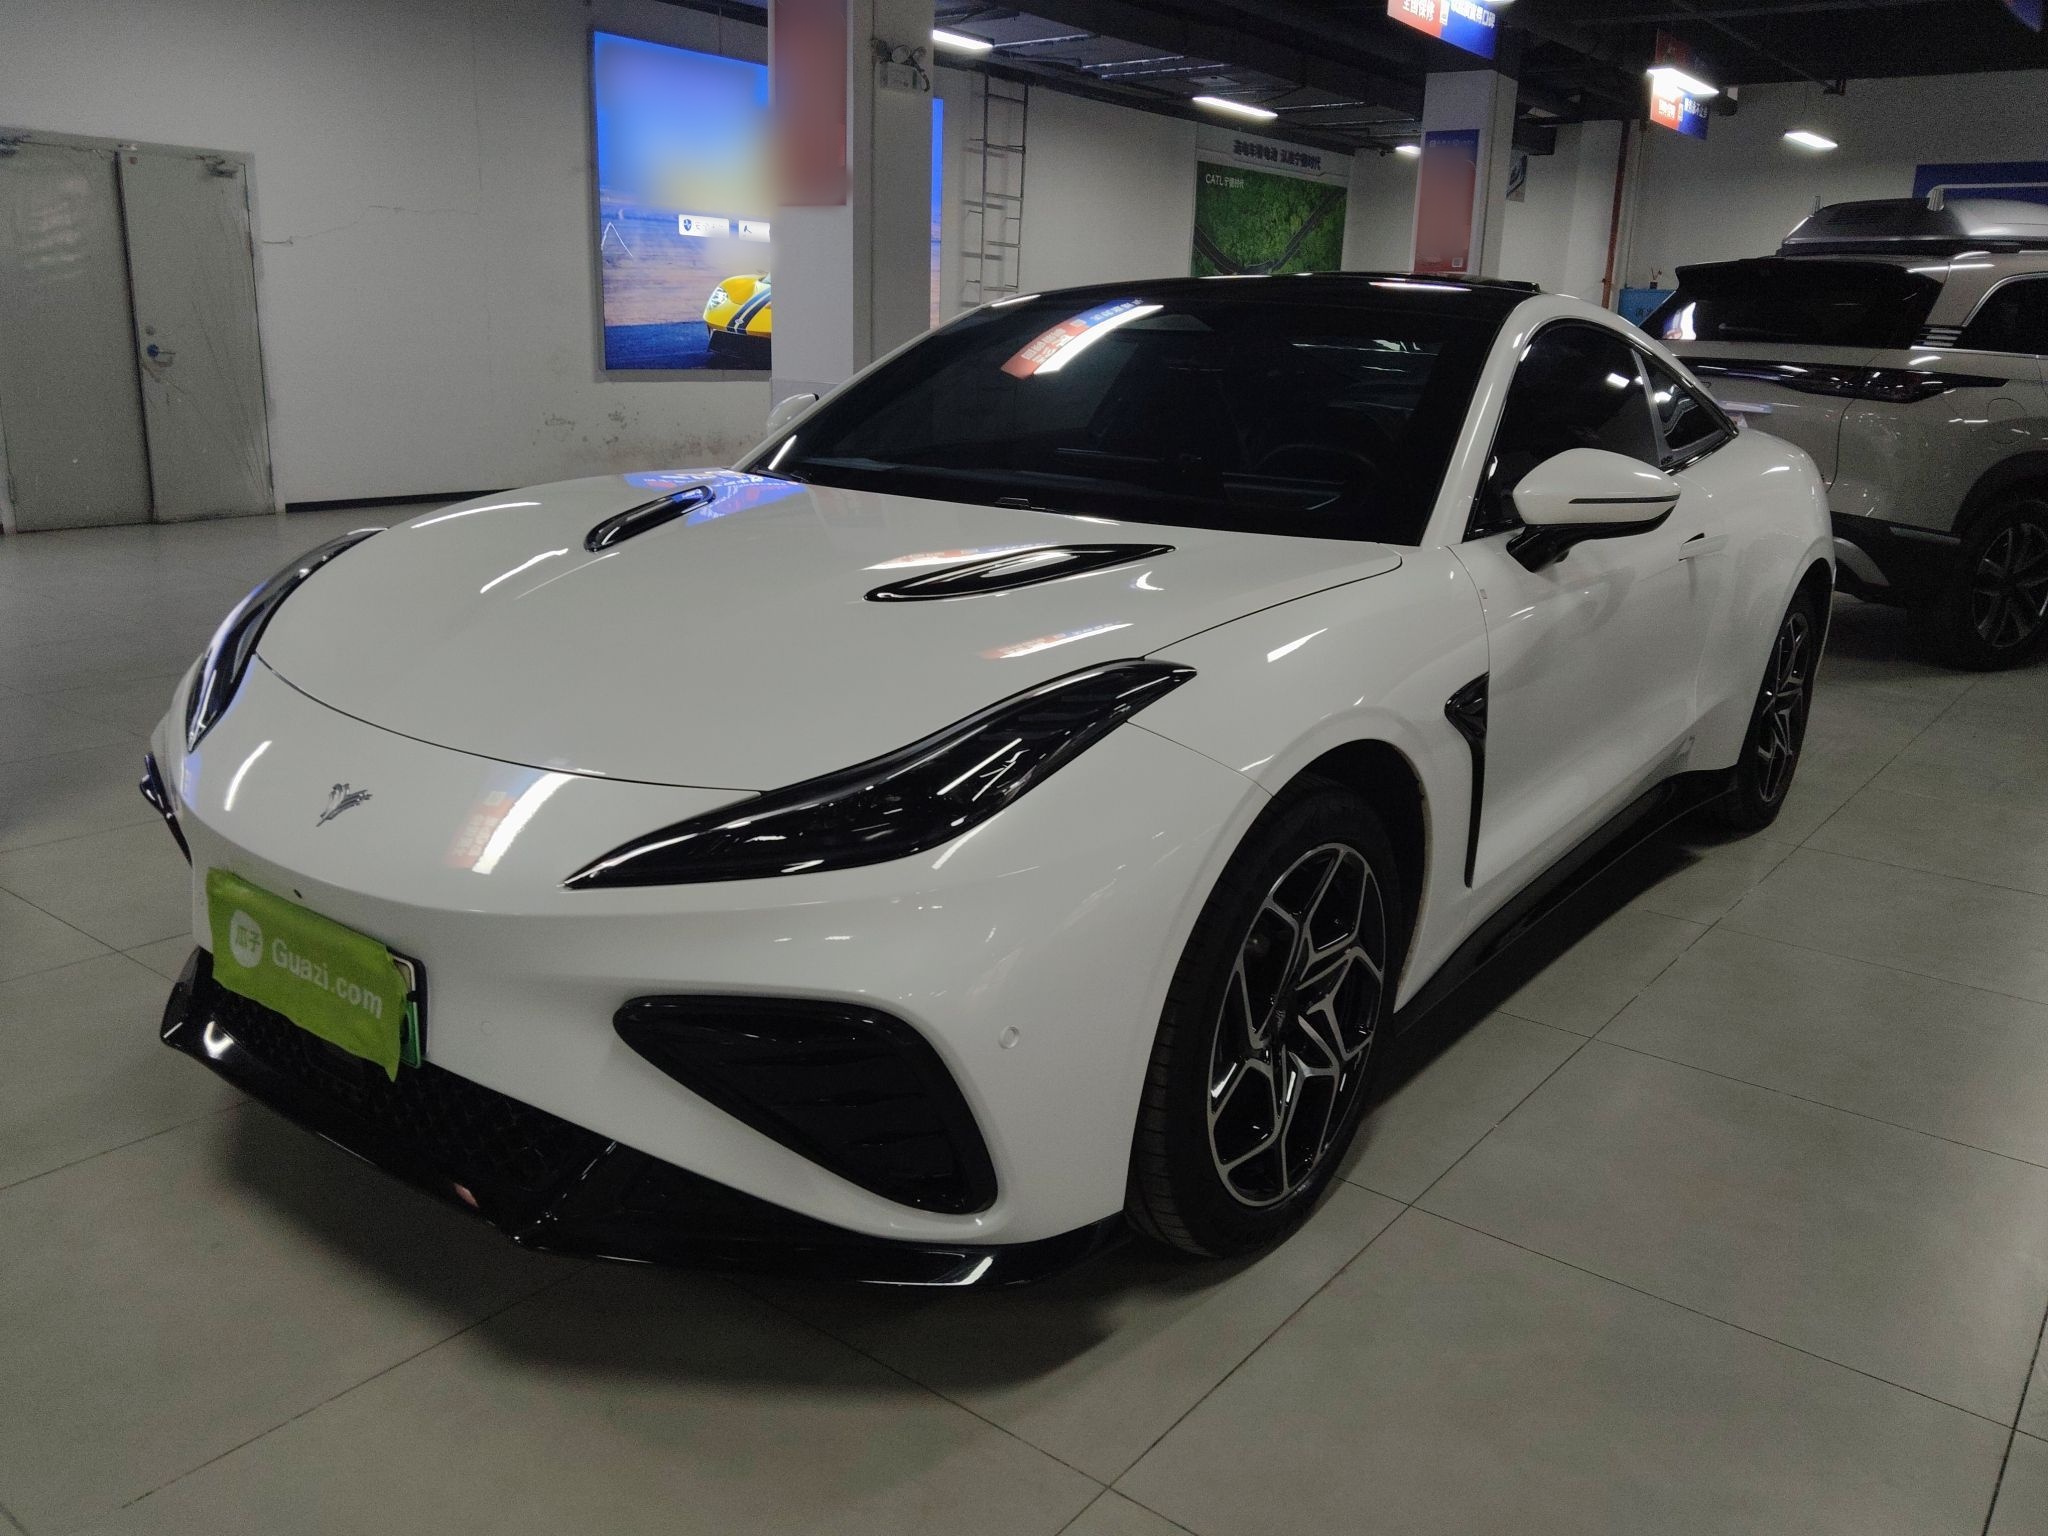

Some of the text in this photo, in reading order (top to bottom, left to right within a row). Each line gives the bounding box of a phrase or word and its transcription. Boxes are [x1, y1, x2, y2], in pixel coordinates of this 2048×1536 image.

[1205, 173, 1223, 186] CATL
[235, 925, 262, 953] 瓜子
[271, 938, 384, 1019] Guazi.com
